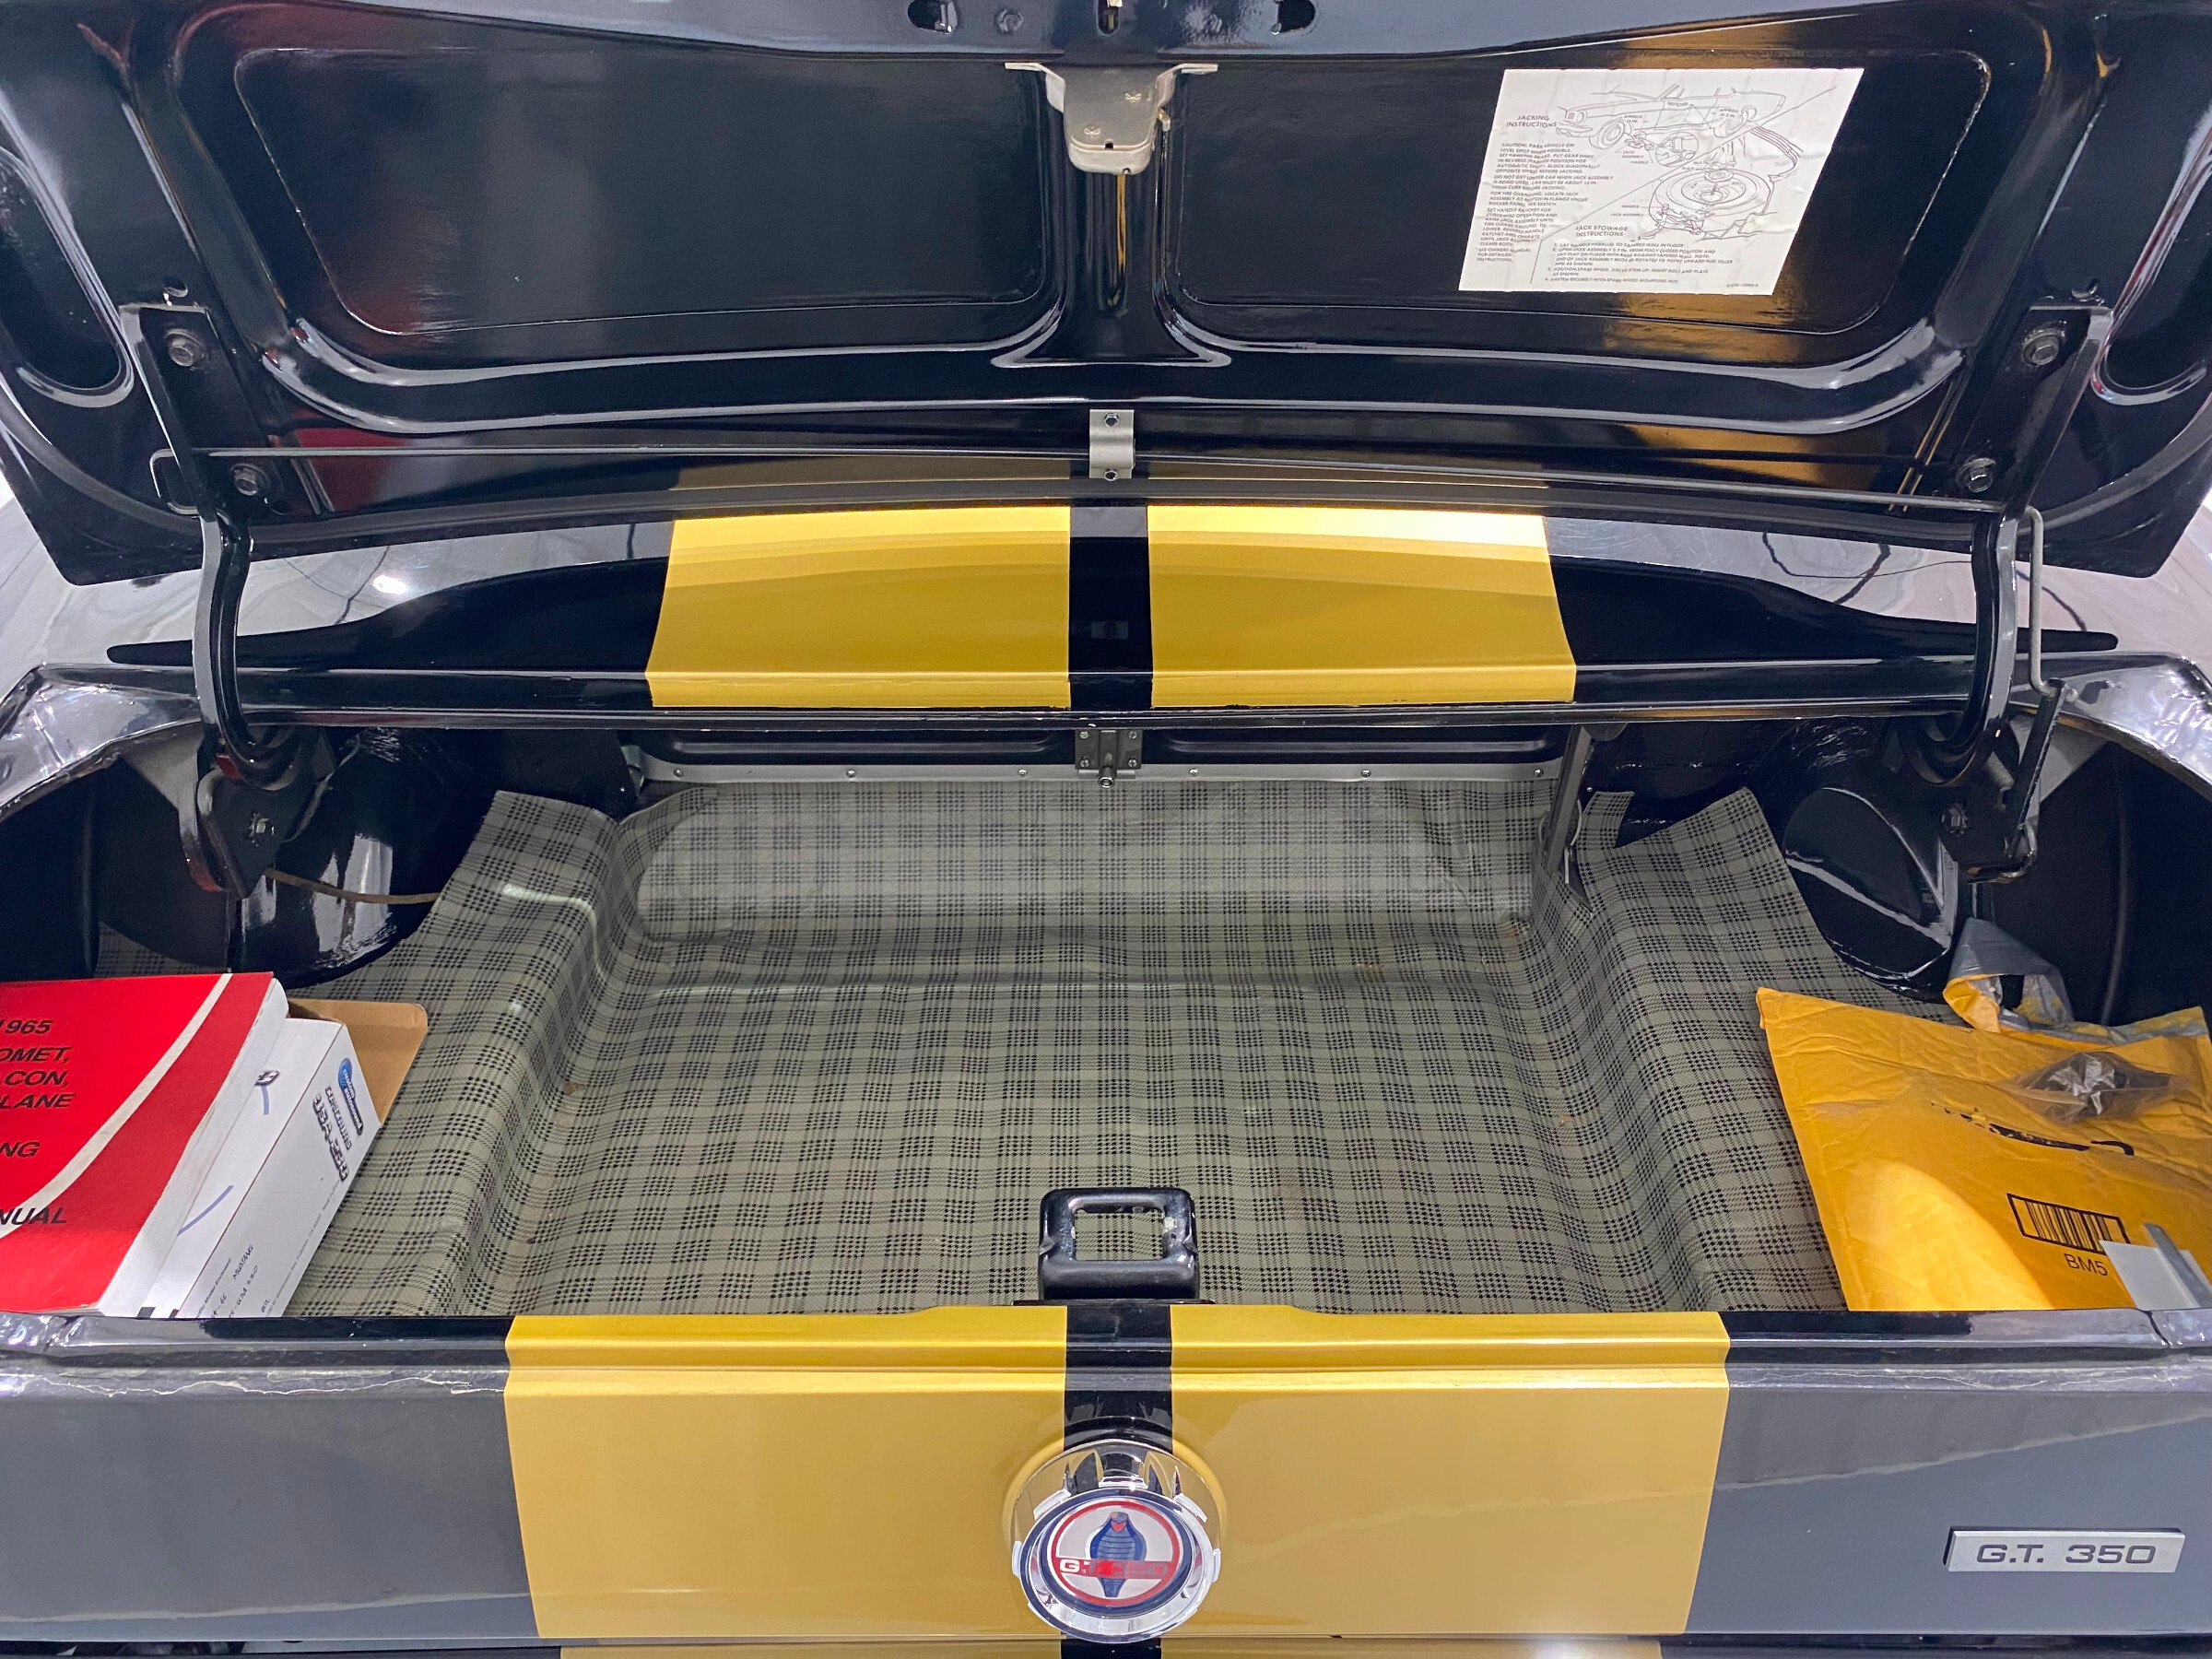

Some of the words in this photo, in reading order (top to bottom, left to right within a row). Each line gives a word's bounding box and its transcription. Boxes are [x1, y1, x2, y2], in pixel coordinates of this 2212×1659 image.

[0, 1020, 53, 1034] 965
[0, 1071, 69, 1087] CON,
[343, 1069, 355, 1098] custom
[344, 1088, 363, 1130] autosound
[233, 1244, 253, 1280] MUSTANG
[2064, 1253, 2108, 1276] BM5
[1977, 1544, 2044, 1563] G.T.
[2065, 1544, 2156, 1564] 350
